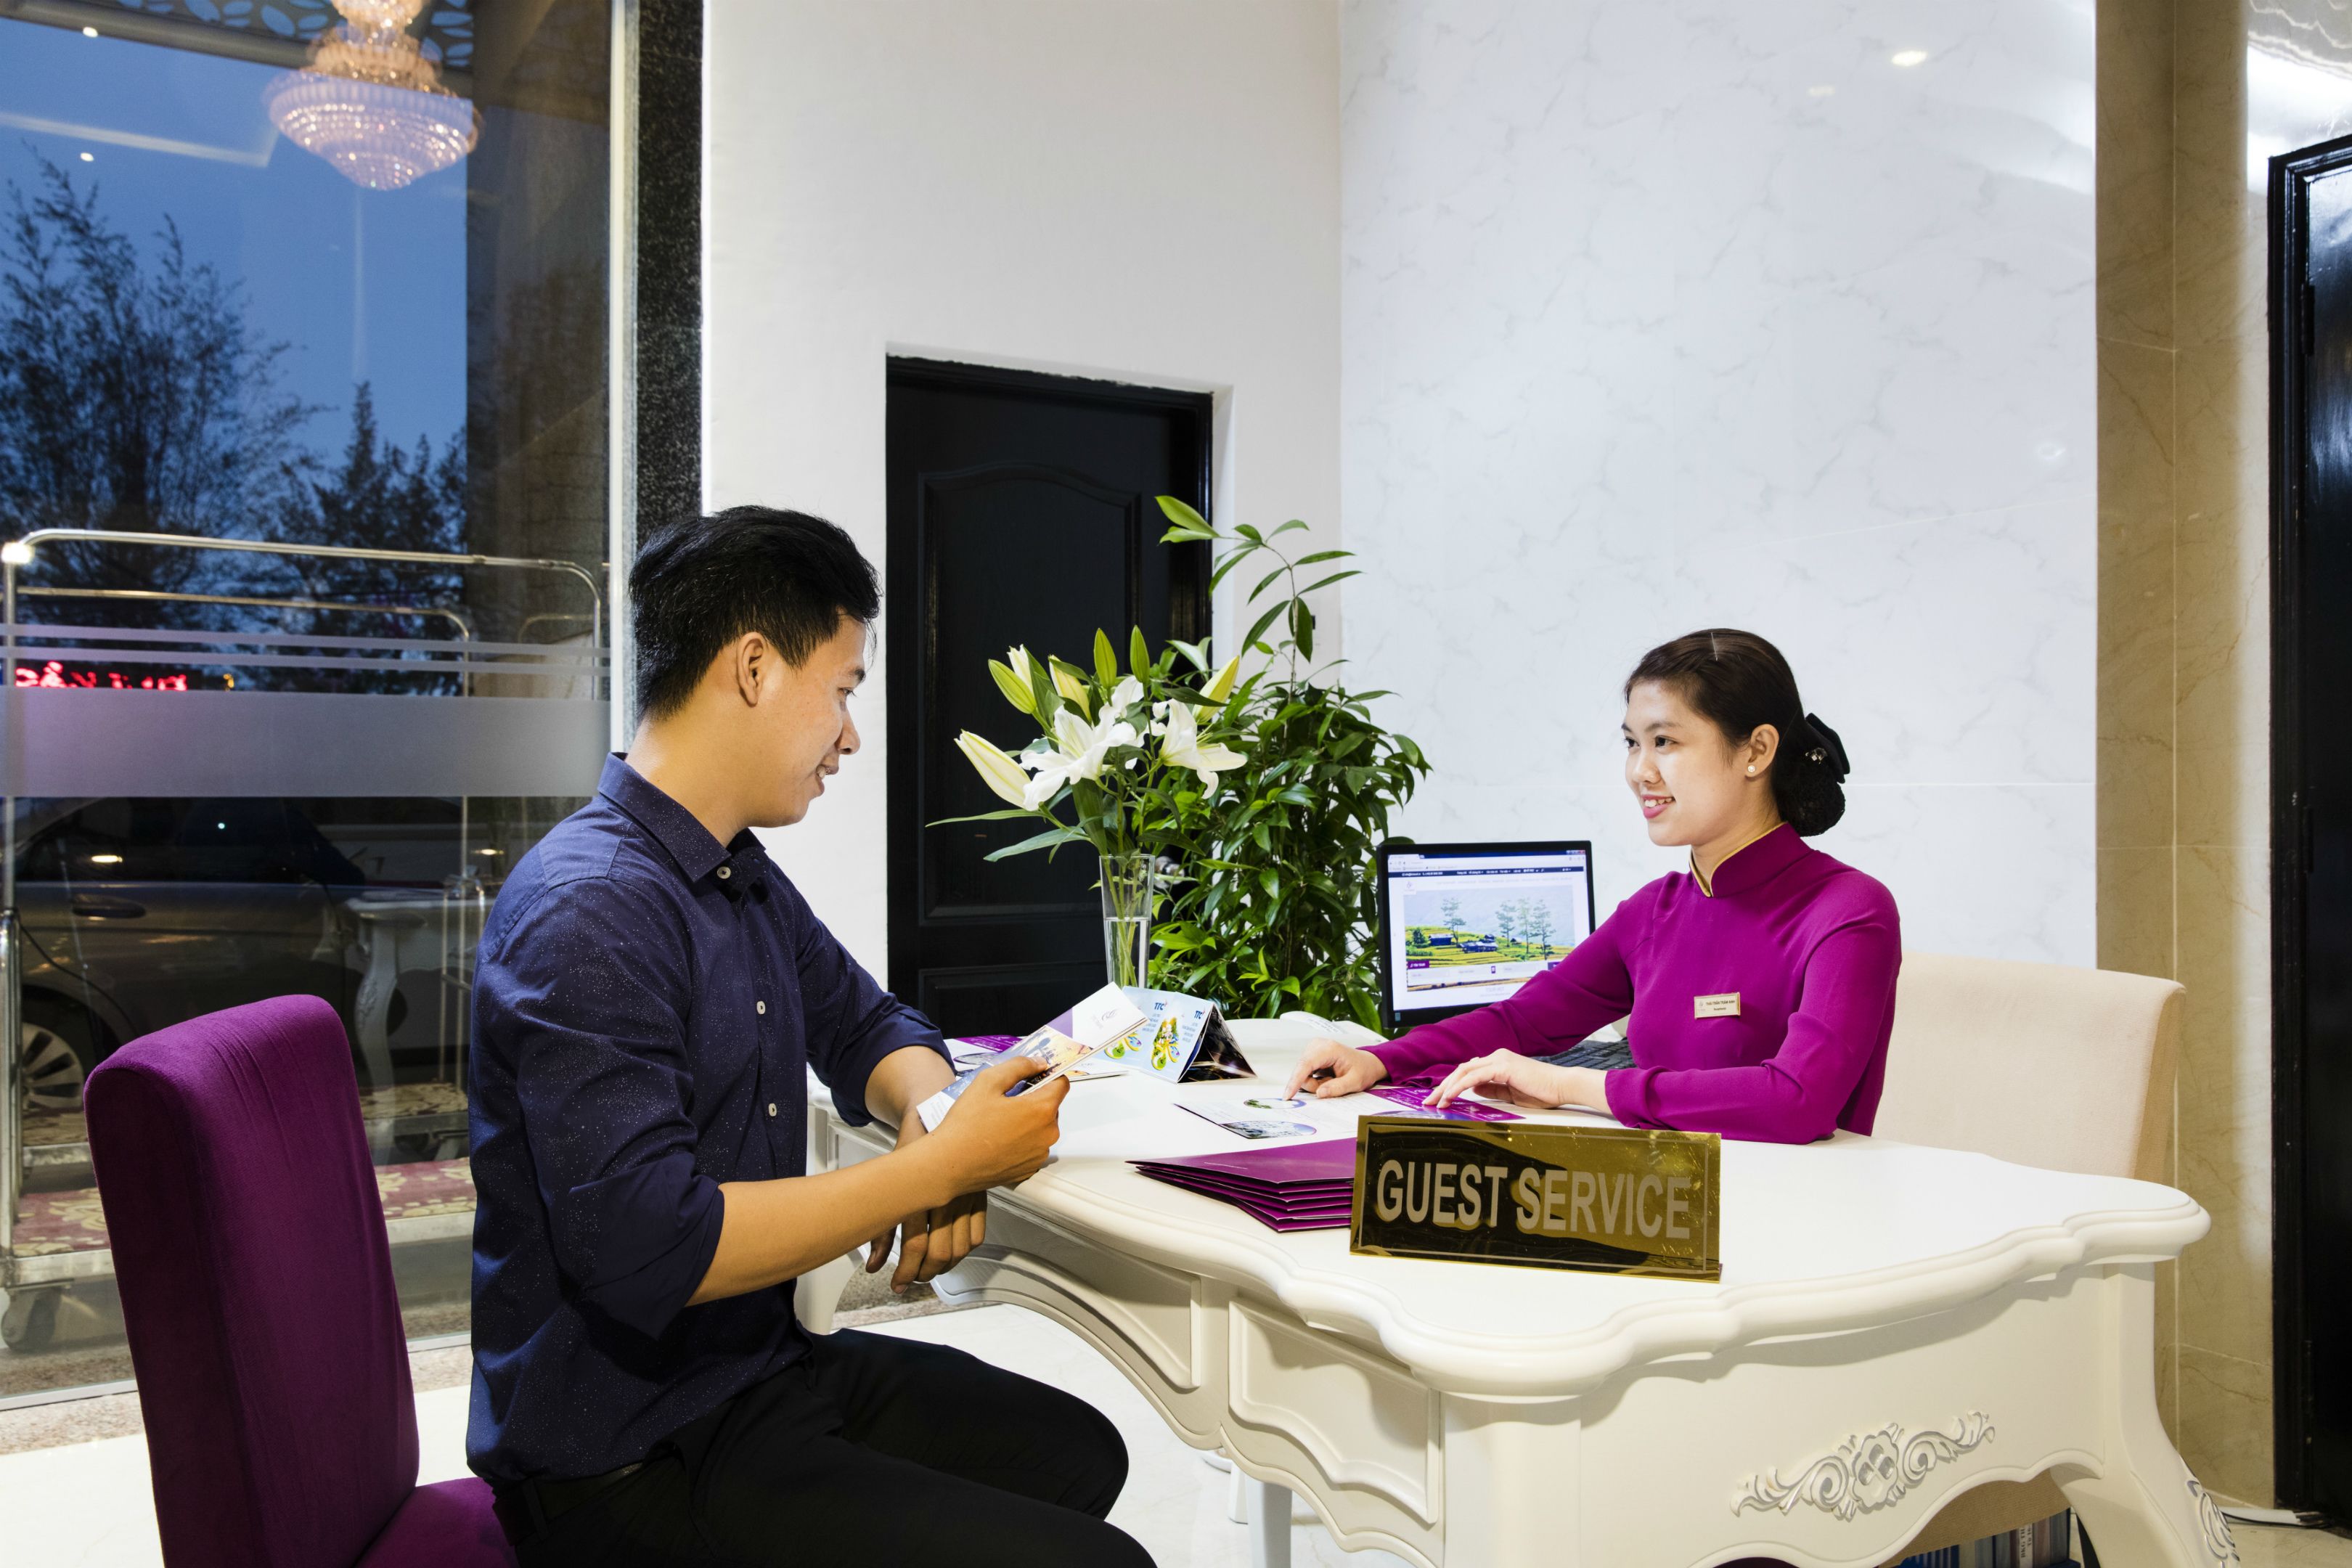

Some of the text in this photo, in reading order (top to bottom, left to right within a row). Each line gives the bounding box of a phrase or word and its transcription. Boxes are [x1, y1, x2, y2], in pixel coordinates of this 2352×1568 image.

[1194, 1010, 1203, 1019] TTC
[1377, 1160, 1691, 1239] GUEST SERVICE
